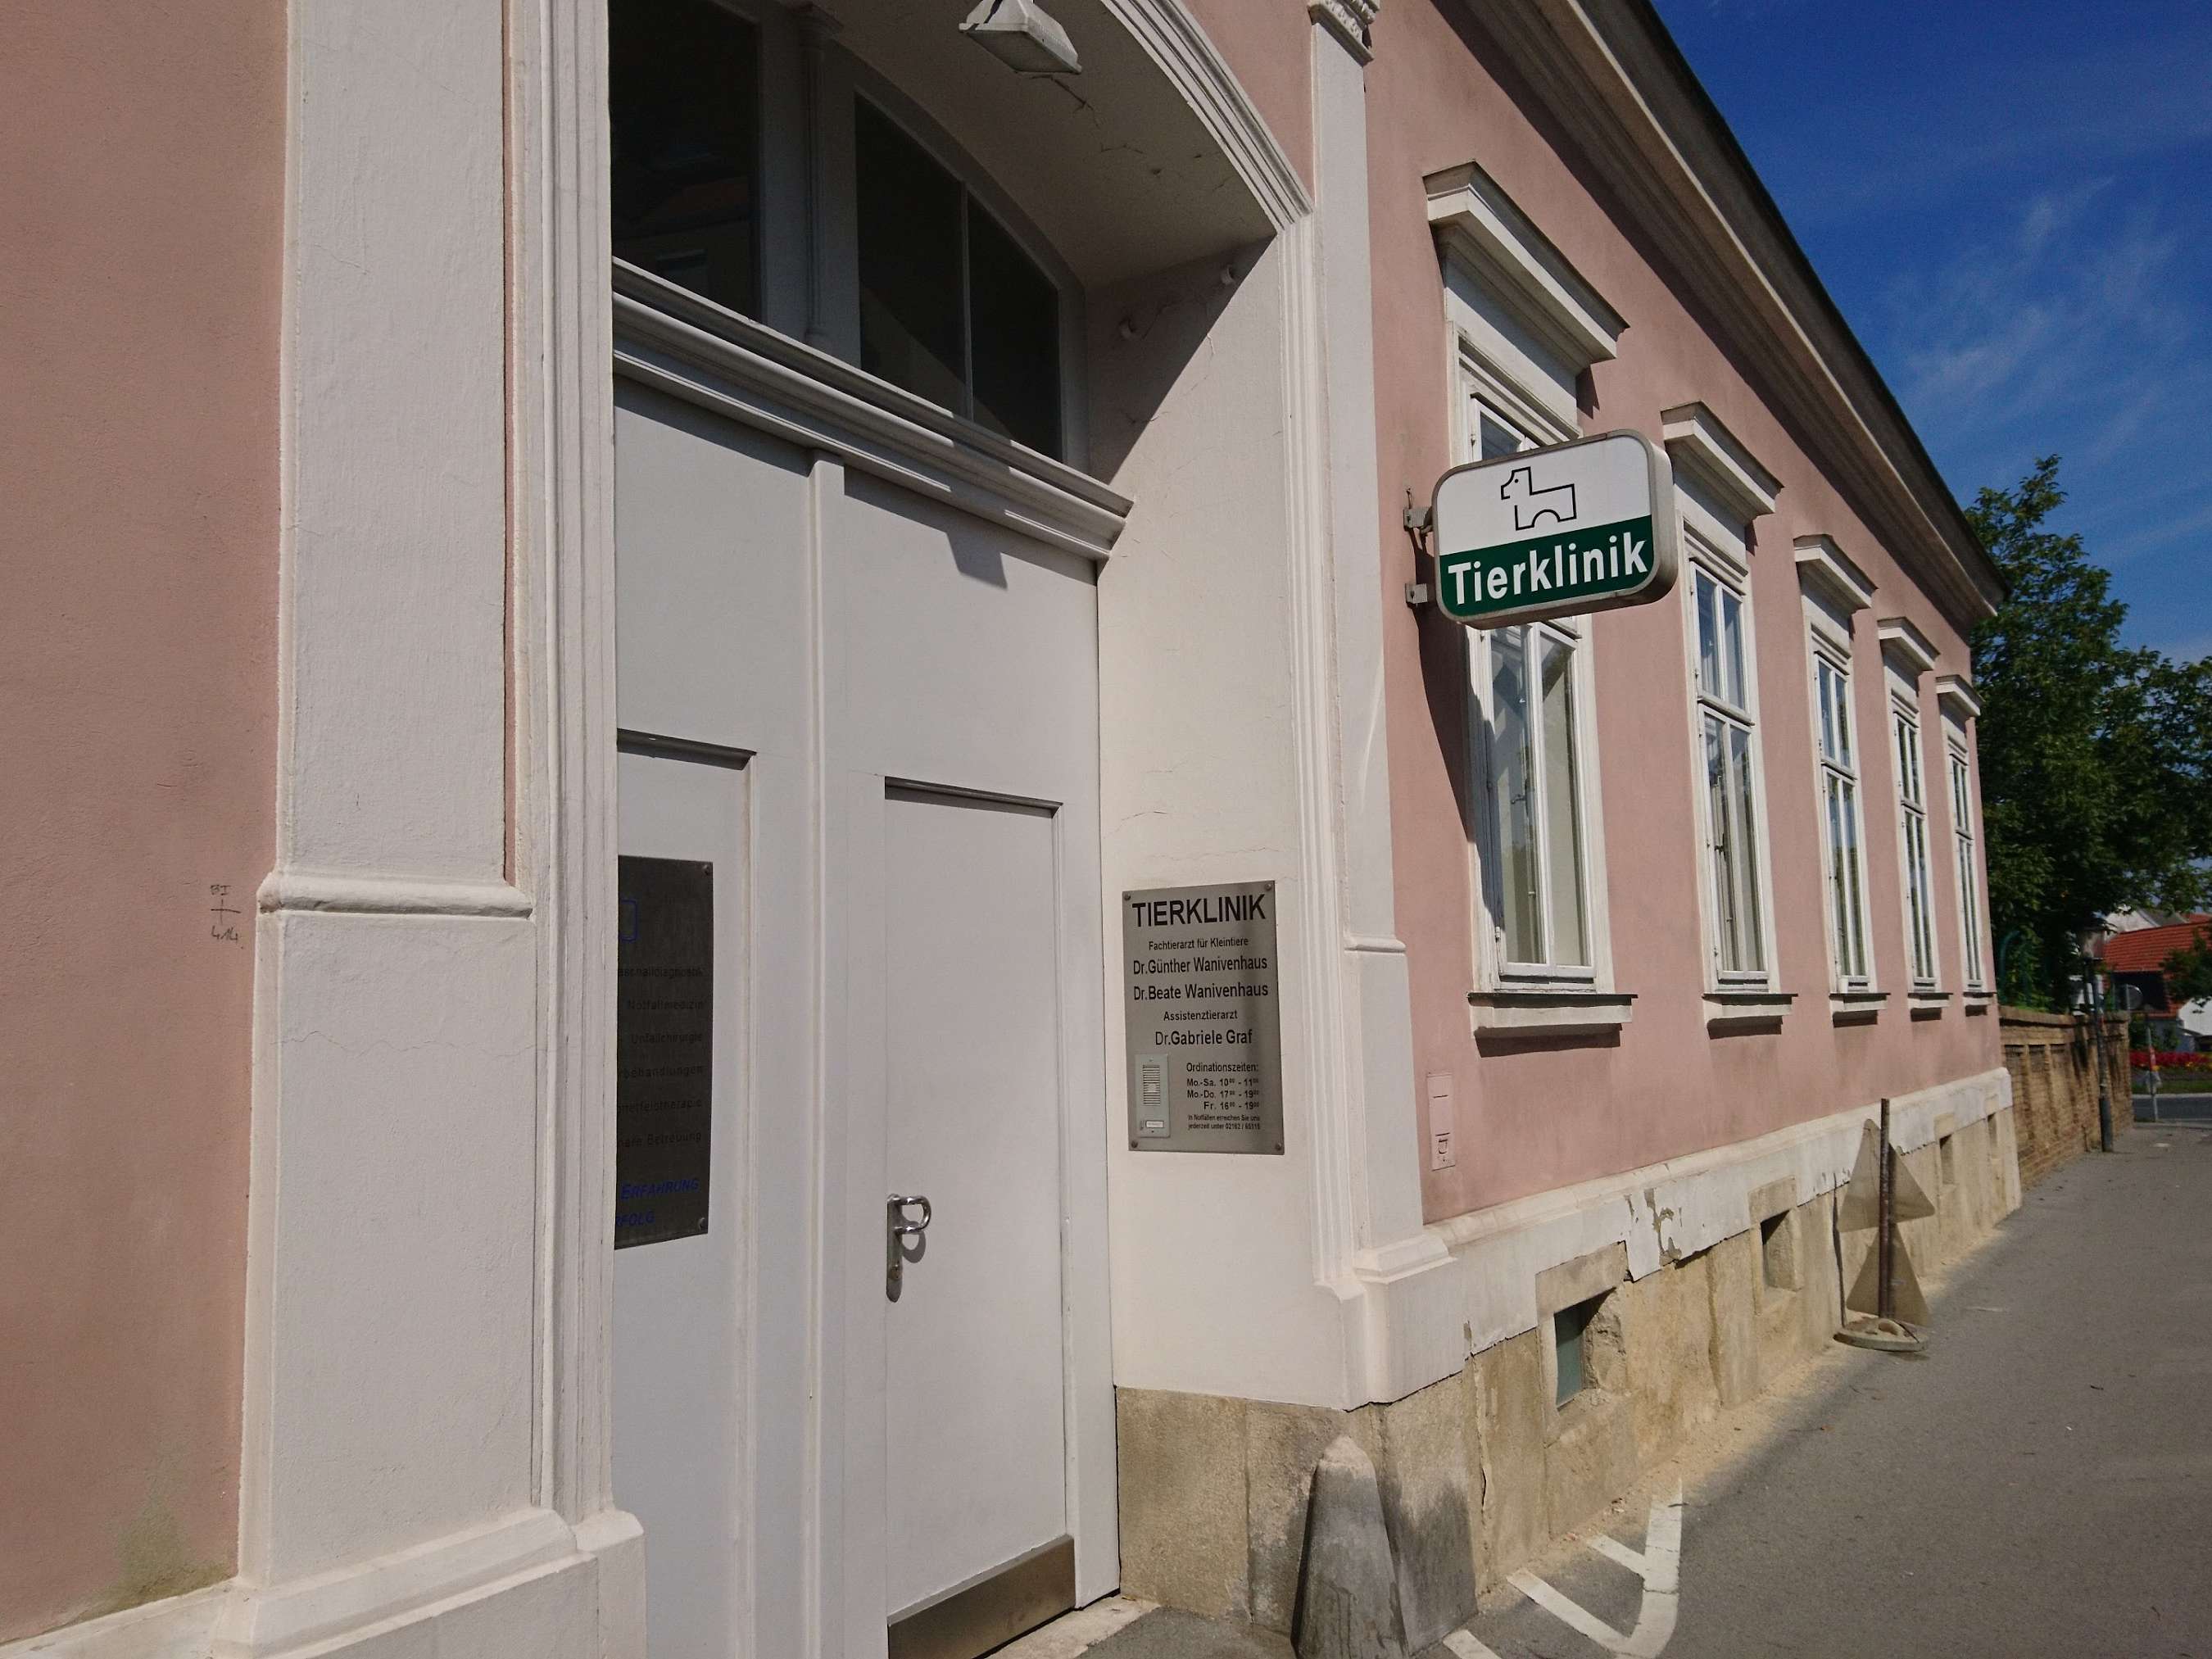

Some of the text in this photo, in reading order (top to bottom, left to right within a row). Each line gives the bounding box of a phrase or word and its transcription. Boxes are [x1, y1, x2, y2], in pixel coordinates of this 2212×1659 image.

[1448, 532, 1648, 605] Tierklinik
[1132, 894, 1266, 927] TIERKLINIK
[1149, 936, 1249, 950] Fachtierarzt für Kleintiere
[1133, 955, 1267, 974] Dr.Günther Wanivenhaus
[1134, 981, 1268, 1000] Dr.Beate Wanivenhaus
[1163, 1009, 1238, 1021] Assistenztierarzt
[1155, 1029, 1253, 1045] Dr.Gabriele Graf
[1186, 1062, 1259, 1072] Ordinationszeiten:
